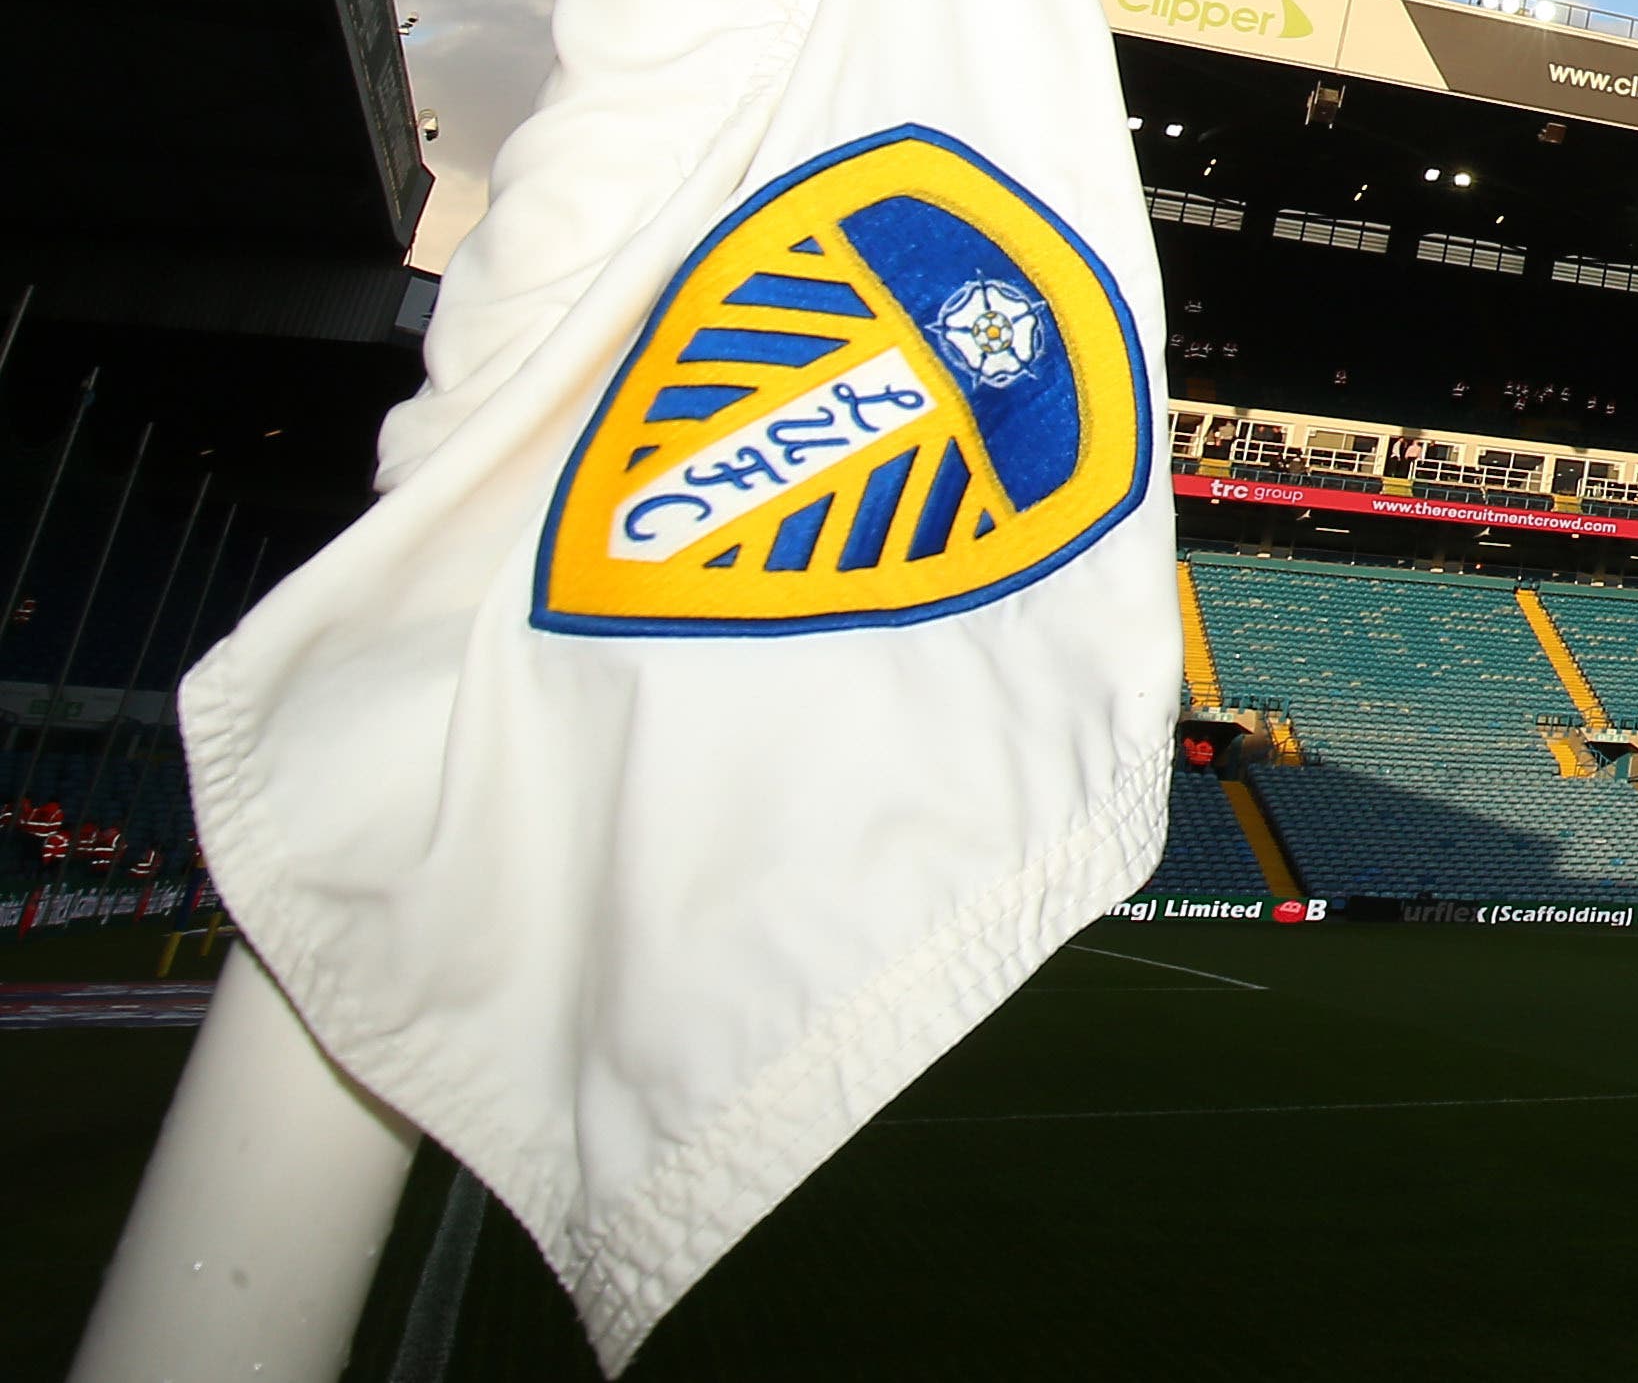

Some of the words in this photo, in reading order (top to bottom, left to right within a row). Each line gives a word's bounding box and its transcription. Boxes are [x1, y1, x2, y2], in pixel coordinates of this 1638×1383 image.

[624, 381, 925, 542] LUFC
[1210, 479, 1249, 499] trc
[1253, 484, 1304, 503] group
[1372, 499, 1617, 533] www.therecruitmentcrowd.com
[1163, 899, 1263, 919] Limited
[1491, 905, 1633, 927] (Scaffolding)
